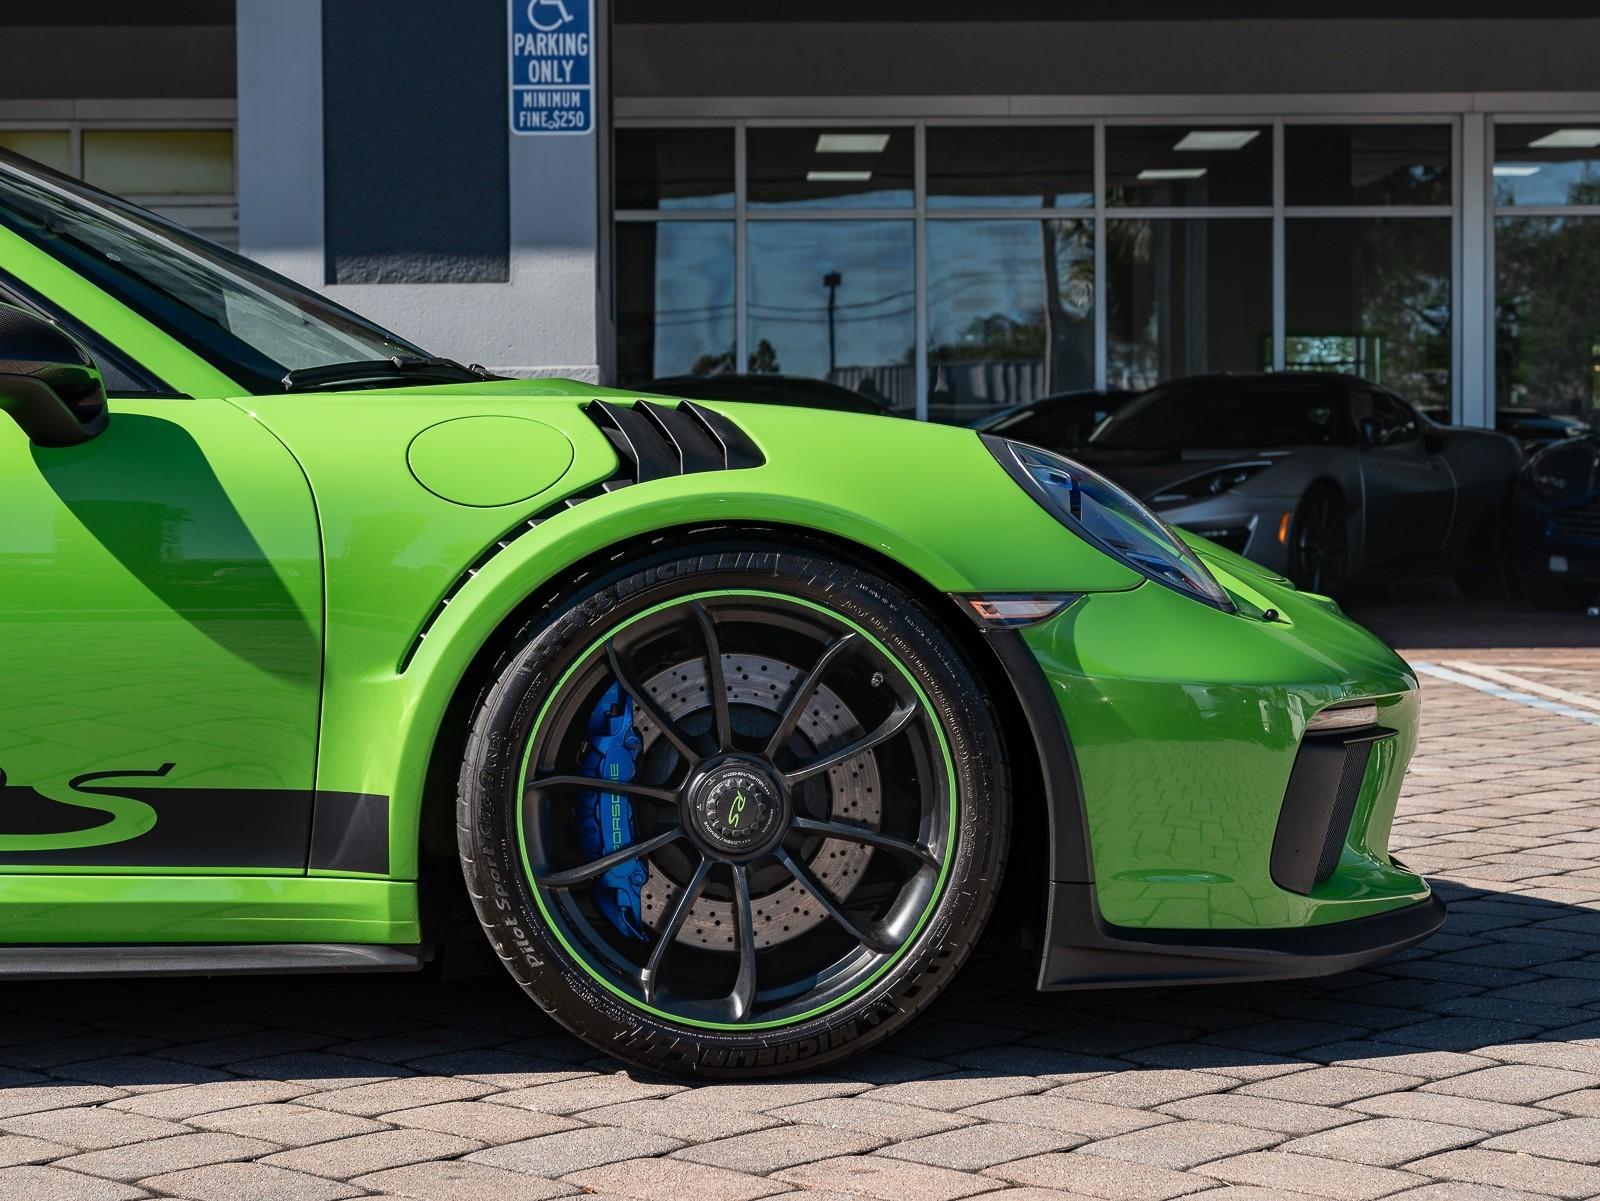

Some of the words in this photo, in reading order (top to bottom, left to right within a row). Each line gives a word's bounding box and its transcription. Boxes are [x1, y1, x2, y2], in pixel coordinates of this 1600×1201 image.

[514, 33, 588, 56] PARKING
[528, 59, 574, 82] ONLY
[523, 91, 580, 107] MINIMUM
[519, 111, 547, 127] FINE
[553, 109, 585, 128] $250
[616, 552, 770, 598] MICHELIN
[728, 790, 746, 828] RS
[483, 845, 512, 911] Sport
[504, 917, 545, 968] Pilot
[700, 1021, 860, 1068] MICHELIN
